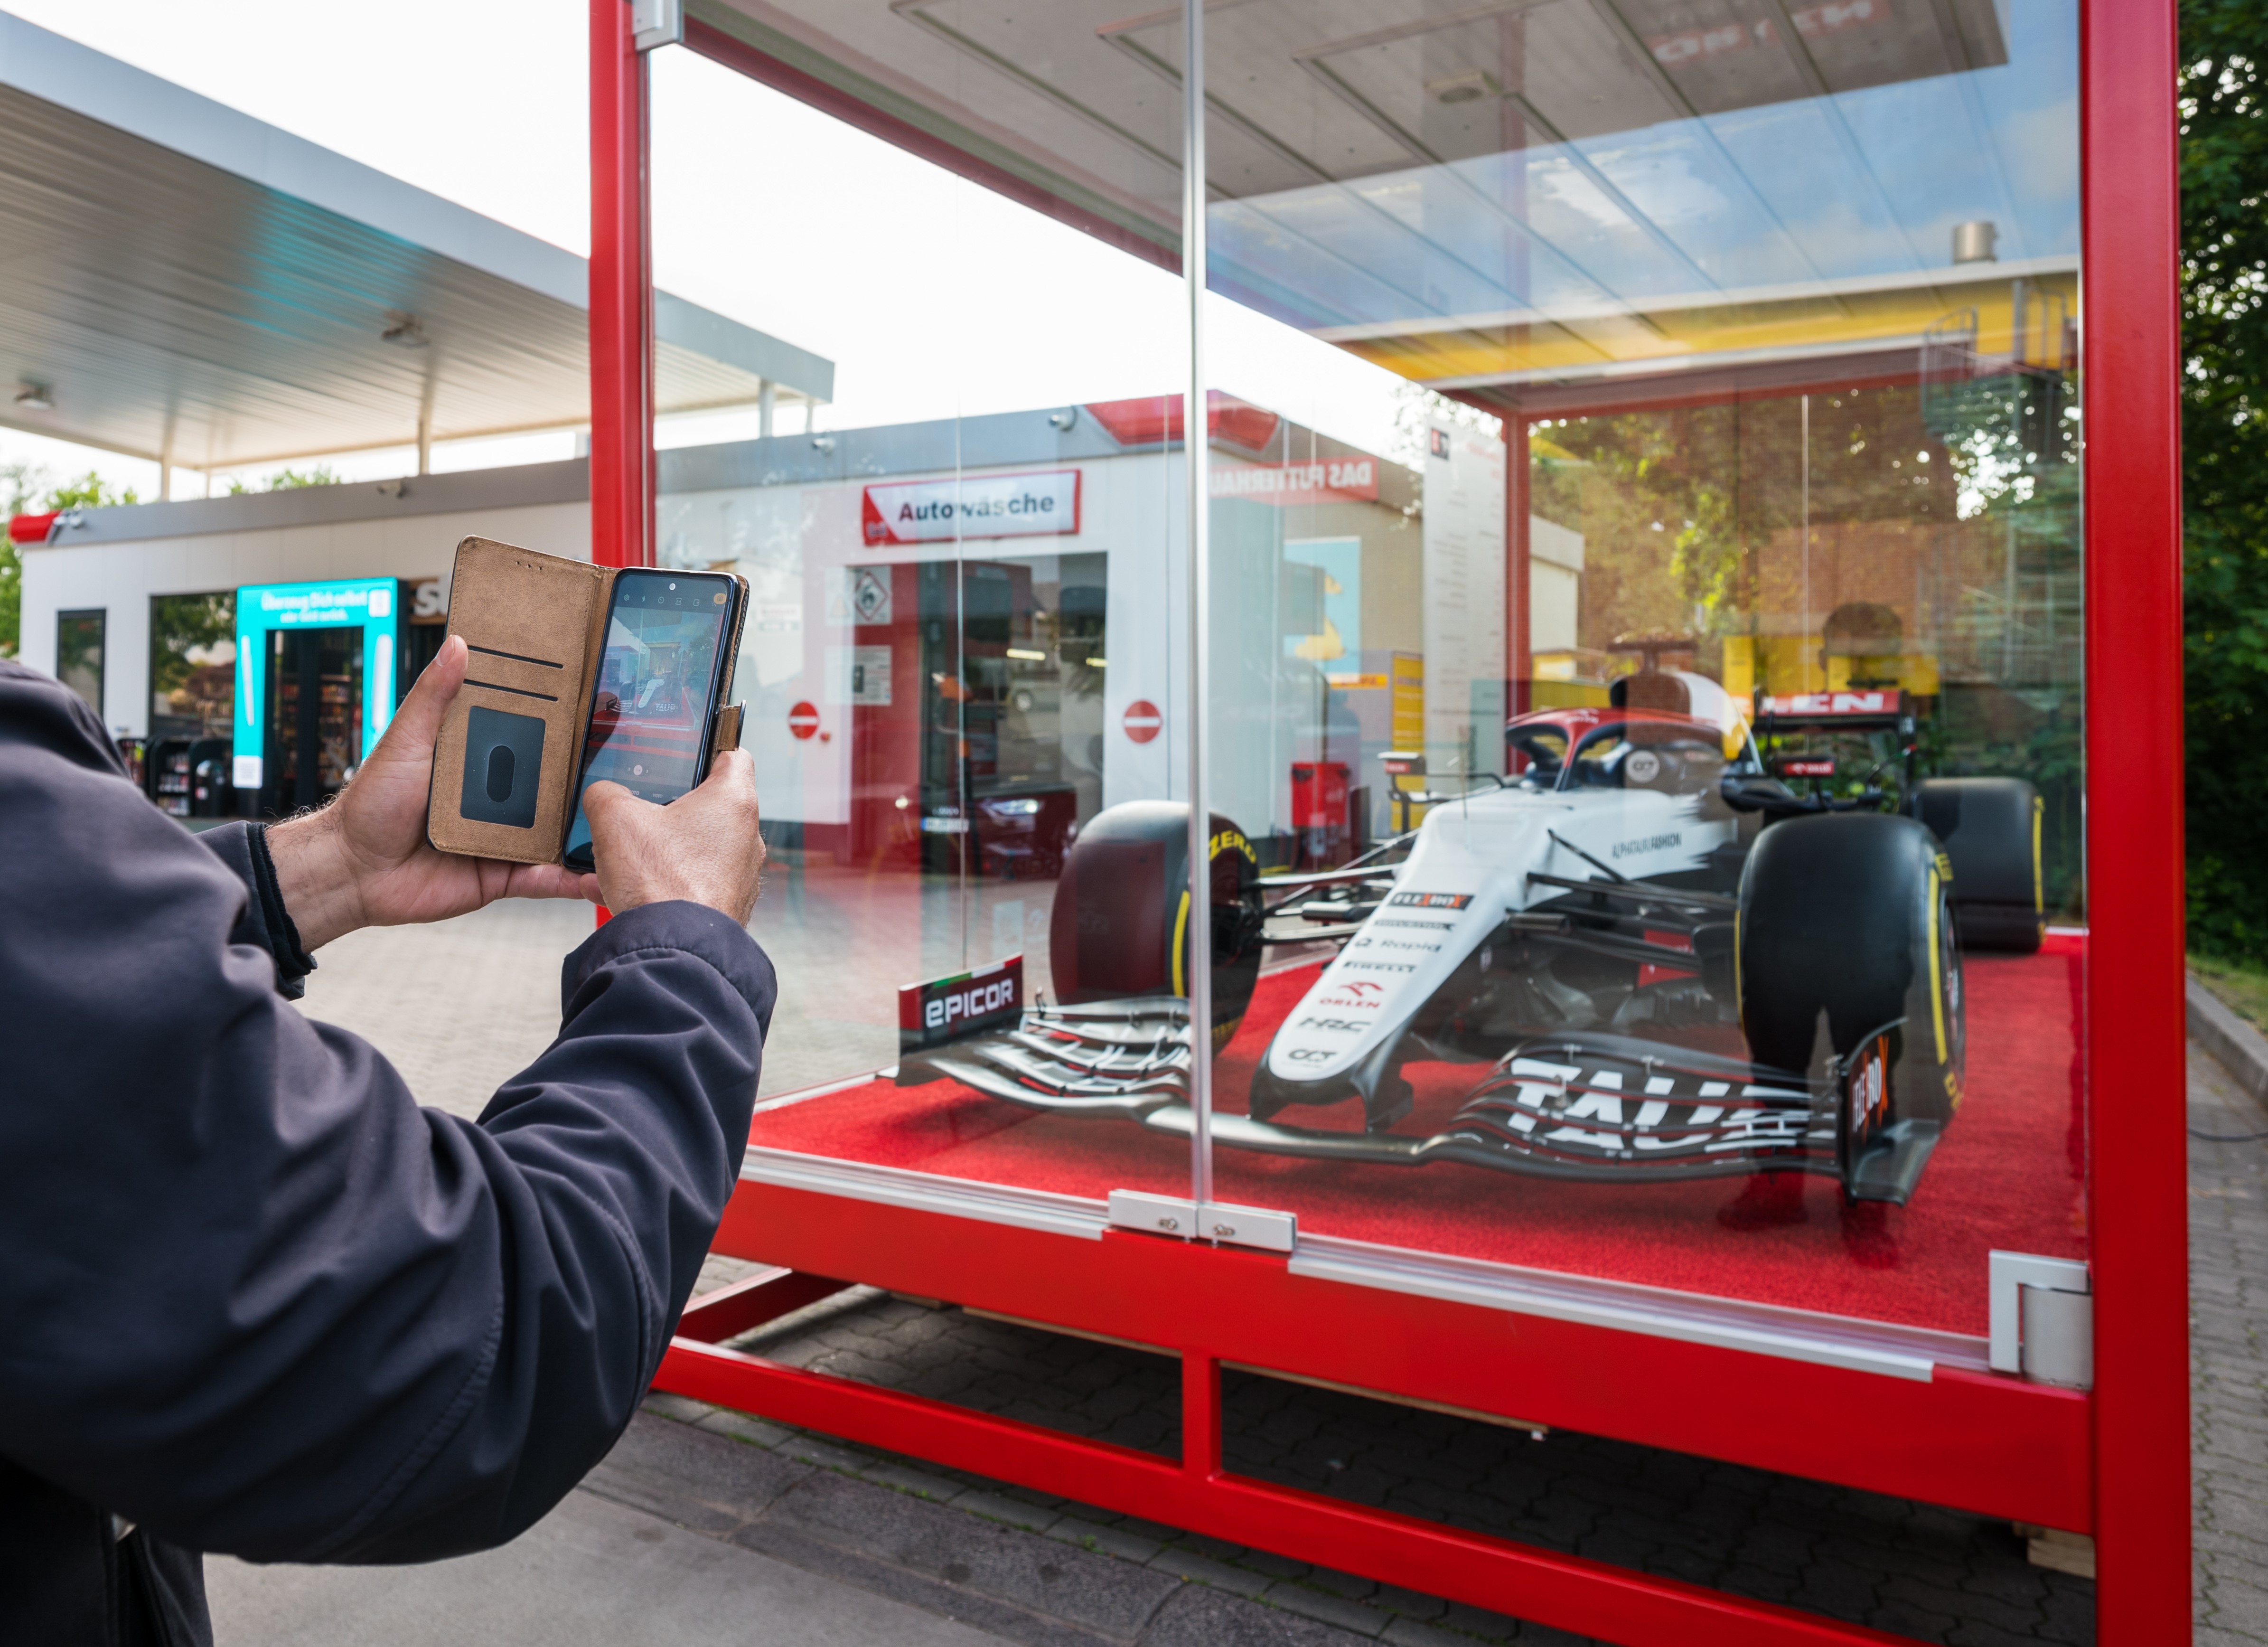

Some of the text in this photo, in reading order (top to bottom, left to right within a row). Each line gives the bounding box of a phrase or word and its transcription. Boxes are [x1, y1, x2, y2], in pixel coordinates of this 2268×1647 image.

[899, 493, 1054, 521] Autowäsche
[1320, 998, 1380, 1008] ORLEN
[1296, 1017, 1372, 1032] HRC
